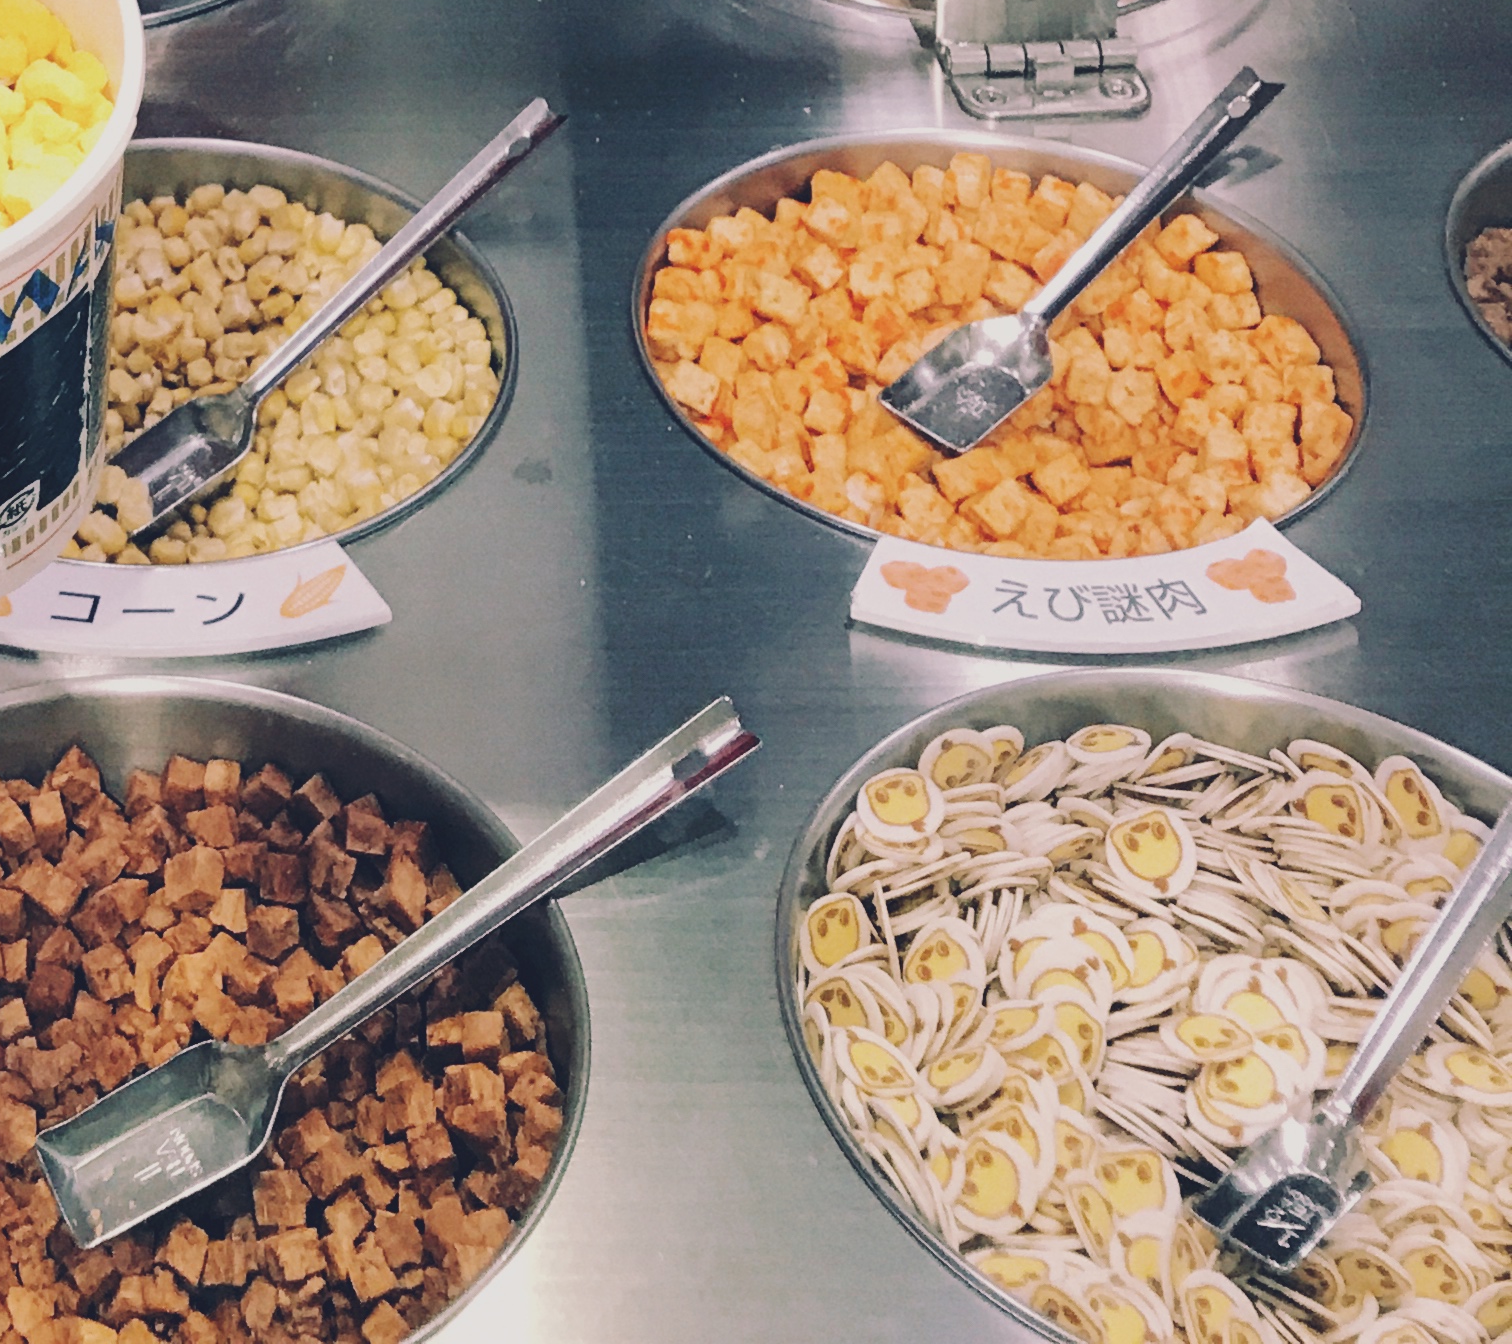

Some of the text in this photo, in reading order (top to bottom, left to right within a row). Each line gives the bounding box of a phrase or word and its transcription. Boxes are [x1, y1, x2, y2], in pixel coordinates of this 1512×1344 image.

[51, 590, 246, 625] コーン
[992, 579, 1207, 624] えび謎肉
